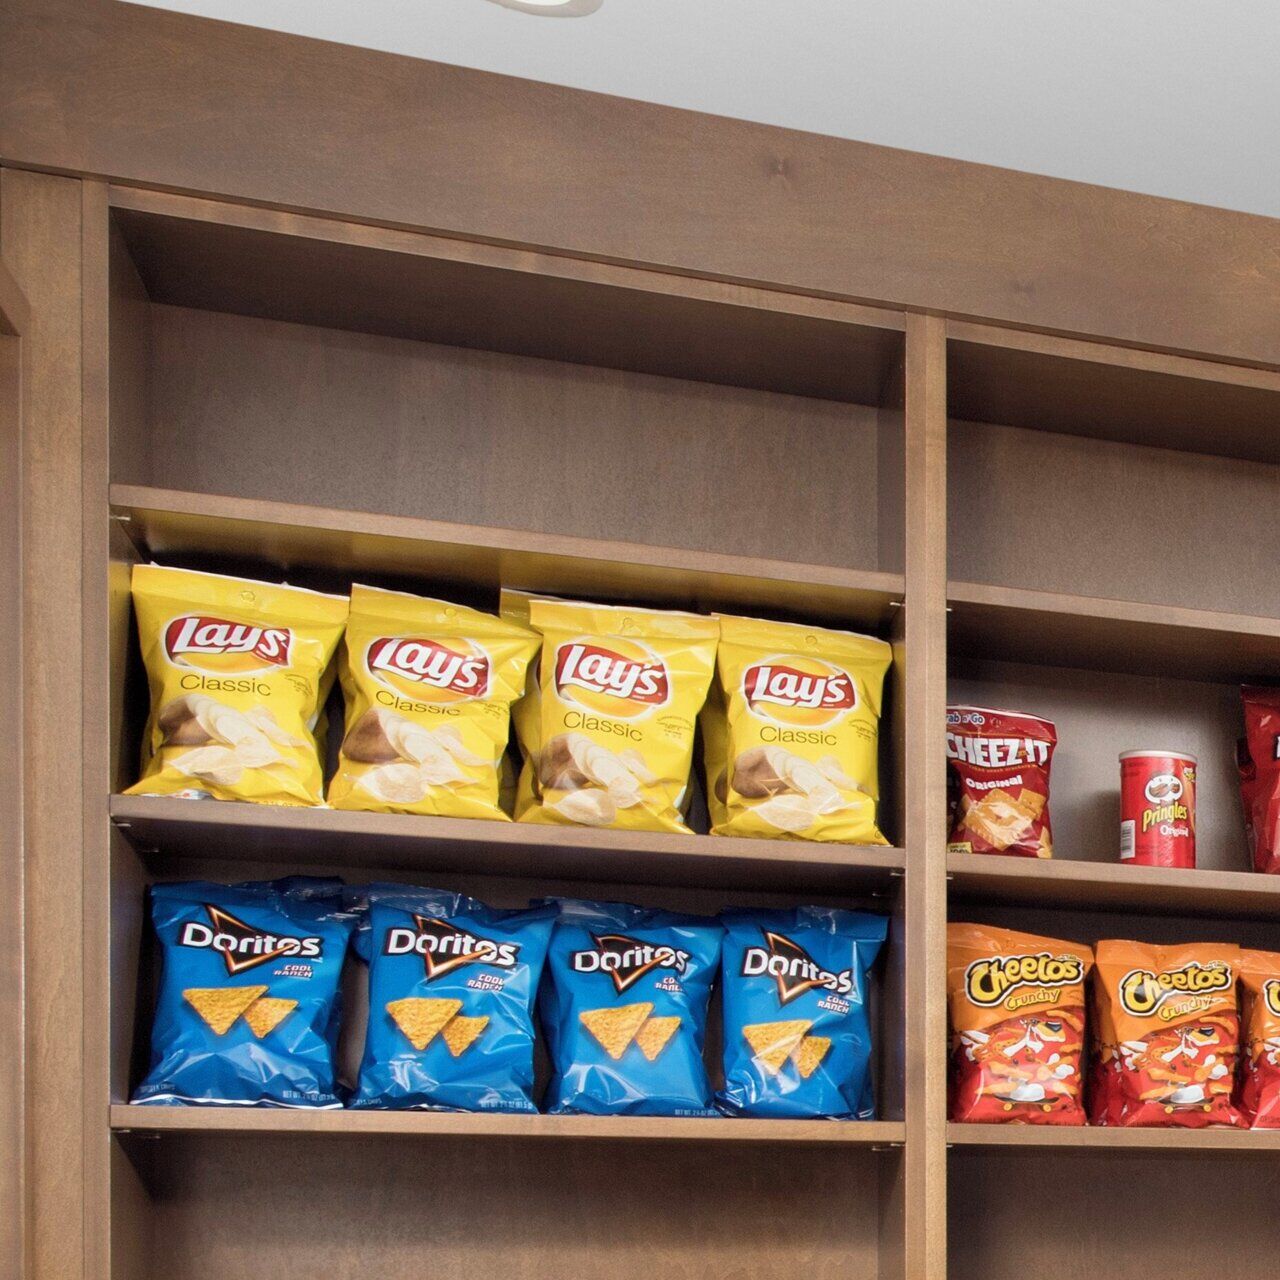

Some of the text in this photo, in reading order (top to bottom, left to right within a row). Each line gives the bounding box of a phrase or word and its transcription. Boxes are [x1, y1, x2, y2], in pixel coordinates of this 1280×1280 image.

[172, 617, 288, 658] Lay's
[373, 638, 487, 688] Lay's
[559, 645, 661, 698] Lay's
[180, 674, 271, 697] Classic
[751, 667, 849, 708] Lay's
[376, 690, 461, 717] Classic
[562, 711, 643, 742] Classic
[760, 726, 837, 746] Classic
[1142, 802, 1188, 832] Pringles
[182, 922, 321, 957] Doritos
[388, 929, 518, 967] Doritos
[283, 964, 313, 972] COOL
[573, 947, 690, 974] Doritos
[743, 947, 853, 994] Doritos
[968, 954, 1082, 1005] Cheetos
[1121, 963, 1231, 1015] Cheetos
[816, 1000, 849, 1015] RANCH
[1004, 989, 1061, 1011] Crunchy
